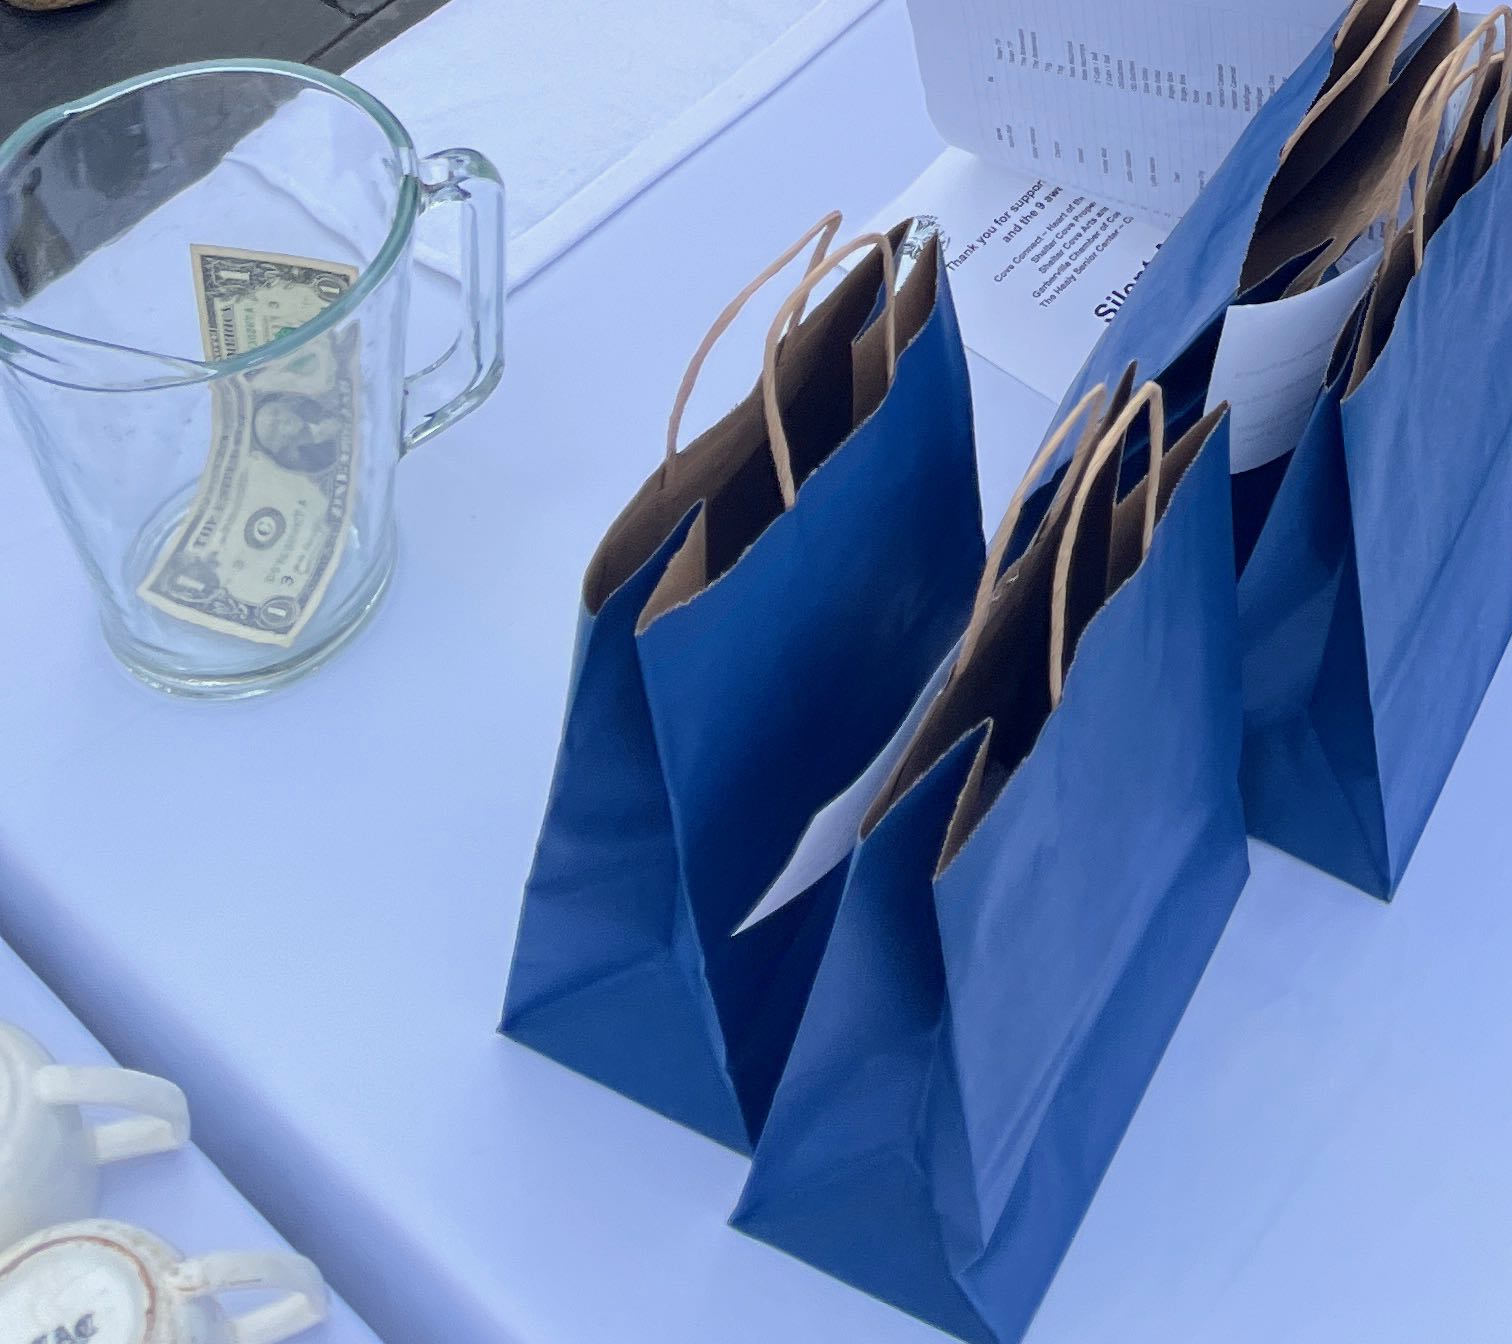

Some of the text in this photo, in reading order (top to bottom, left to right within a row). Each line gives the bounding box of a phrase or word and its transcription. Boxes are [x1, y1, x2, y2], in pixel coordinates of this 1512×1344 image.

[946, 180, 1046, 271] Thank you for suppor
[994, 264, 1014, 282] Cove
[1013, 236, 1044, 264] Connect
[1046, 212, 1068, 231] Heart
[1065, 203, 1076, 213] of
[1003, 224, 1022, 243] and
[1019, 210, 1038, 225] the
[1035, 201, 1045, 209] 9
[1030, 239, 1057, 264] Shelter
[1055, 222, 1076, 240] Cove
[1038, 249, 1065, 274] Shelter
[1062, 232, 1083, 250] Cove
[1080, 217, 1098, 233] Arts
[1068, 231, 1101, 262] Chamber
[1099, 221, 1110, 233] of
[1039, 293, 1058, 308] The
[1073, 252, 1099, 275] Senior
[1095, 229, 1120, 252] Center
